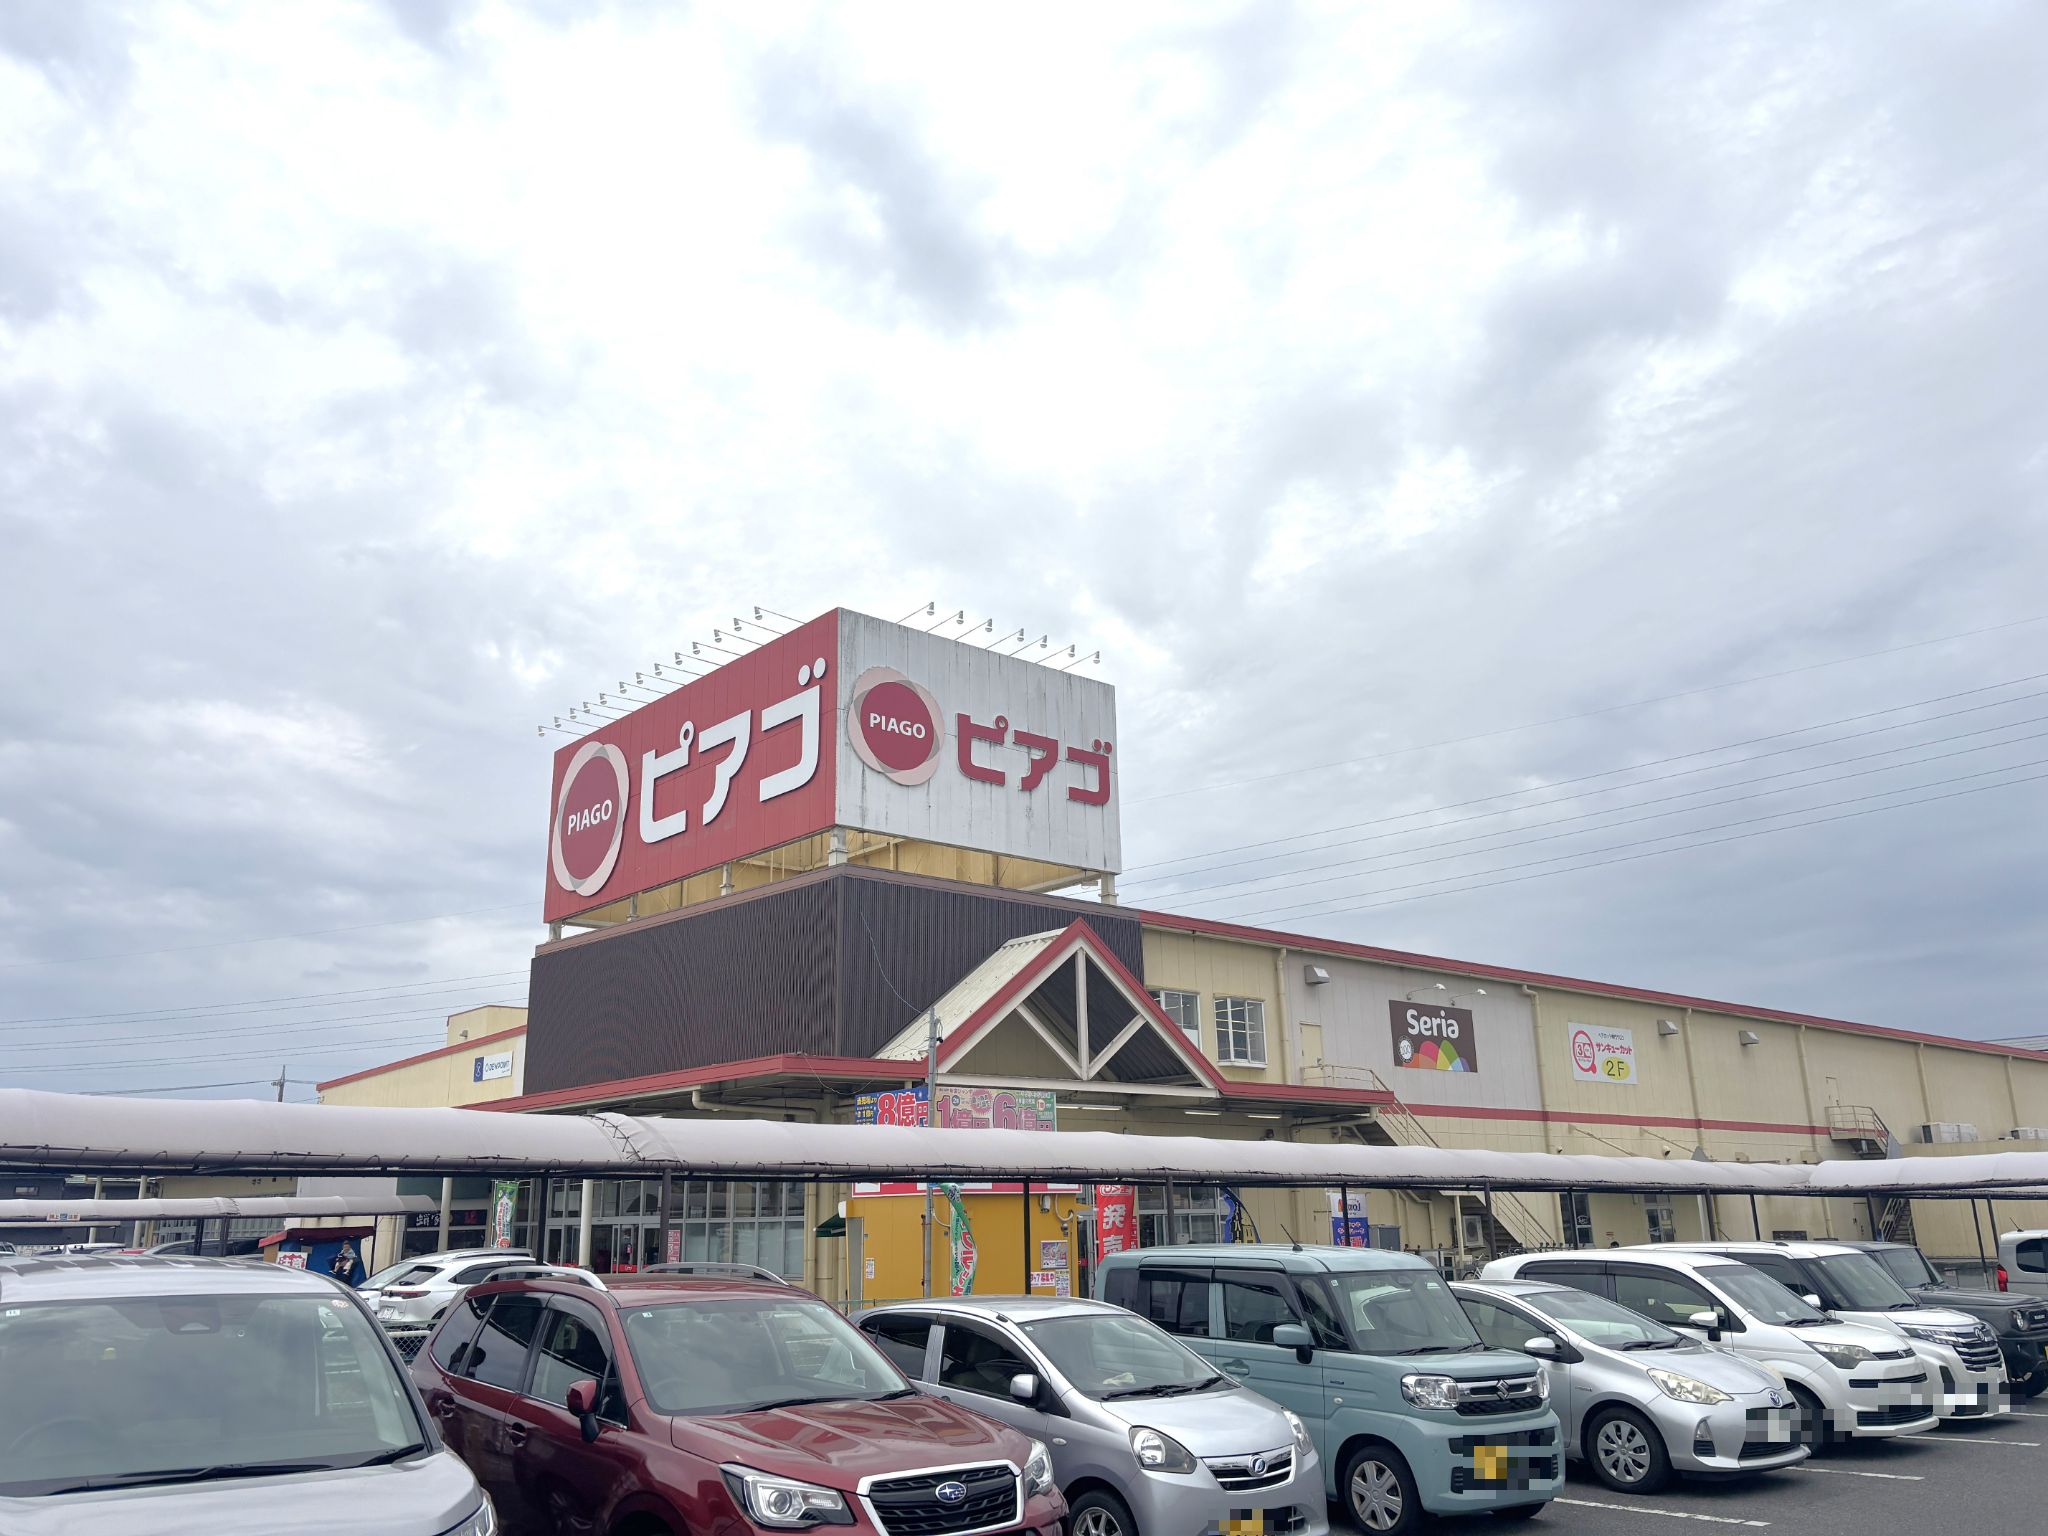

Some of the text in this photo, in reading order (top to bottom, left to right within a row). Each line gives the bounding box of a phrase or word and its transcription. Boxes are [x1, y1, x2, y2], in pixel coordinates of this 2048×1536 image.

[869, 712, 926, 740] PIAGO
[639, 657, 827, 844] ピアゴ
[956, 712, 1111, 806] ピアゴ
[567, 798, 613, 837] PIAGO
[1406, 1008, 1459, 1039] Seria
[1606, 1060, 1625, 1077] 2F
